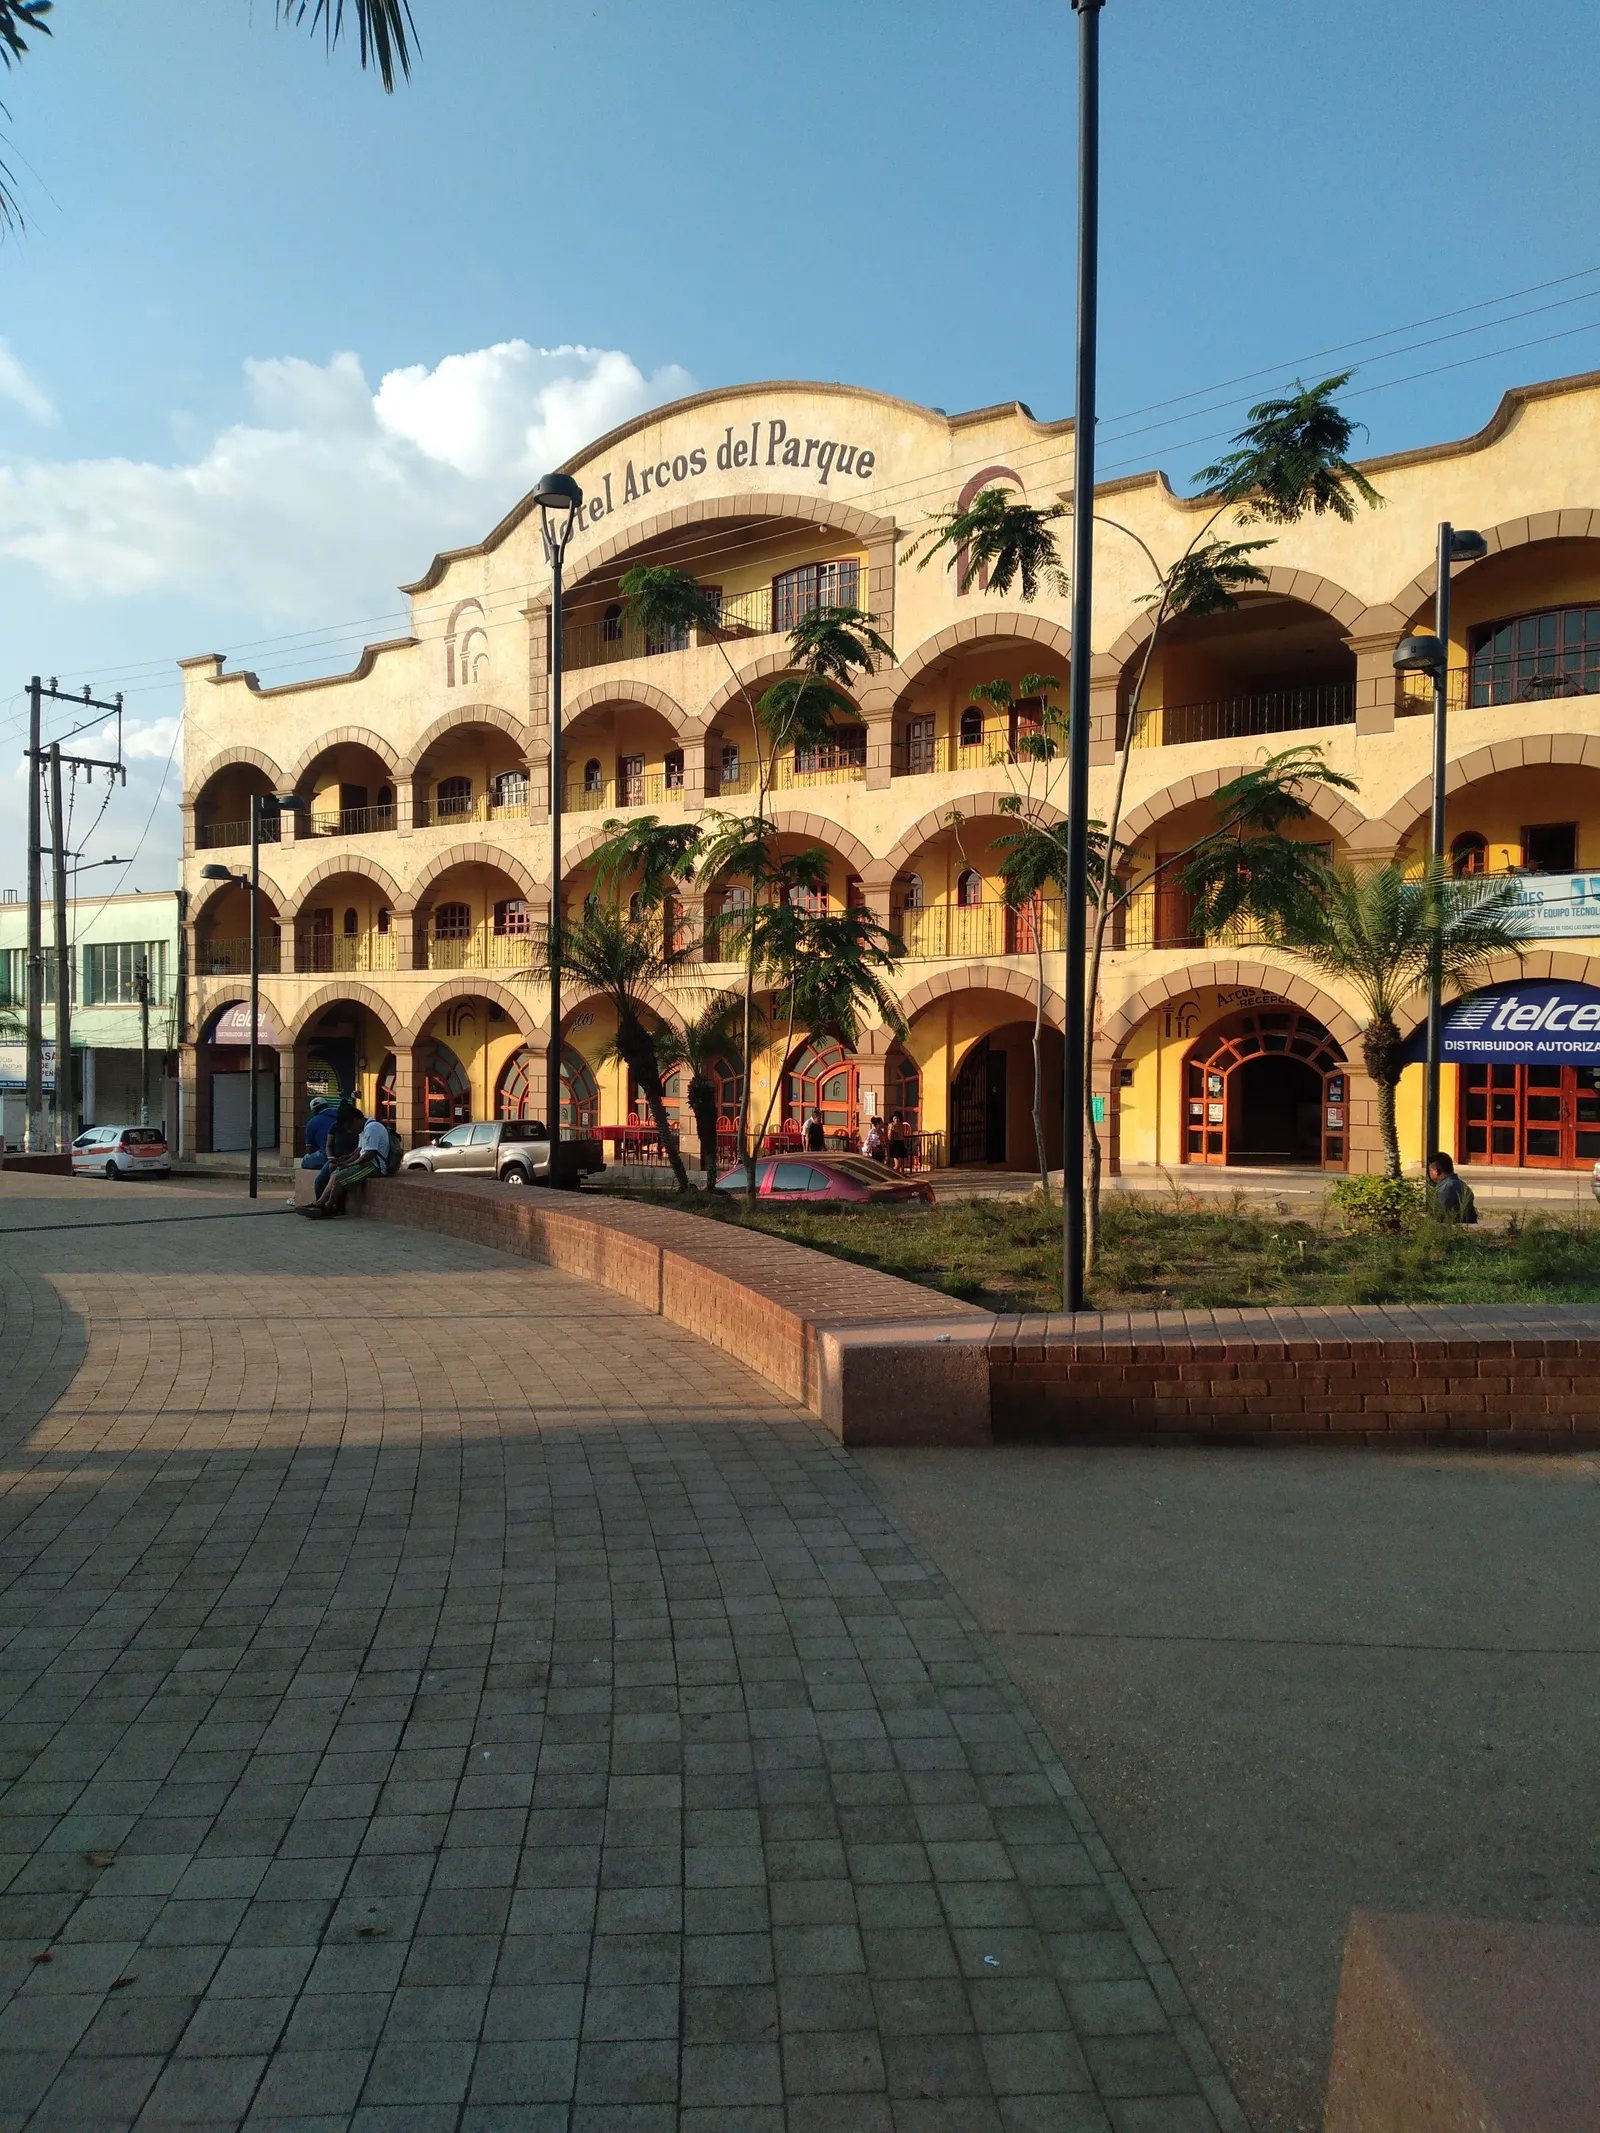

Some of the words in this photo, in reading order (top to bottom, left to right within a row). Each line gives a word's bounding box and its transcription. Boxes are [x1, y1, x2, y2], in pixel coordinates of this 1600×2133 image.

[622, 446, 707, 505] Arcos
[716, 422, 761, 471] del
[765, 419, 876, 485] Parque
[1537, 909, 1542, 918] Y
[1543, 908, 1570, 918] EQUIPO
[1217, 987, 1256, 1007] Arcos
[1491, 997, 1600, 1031] telce
[1445, 1040, 1534, 1051] DISTRIBUIDOR
